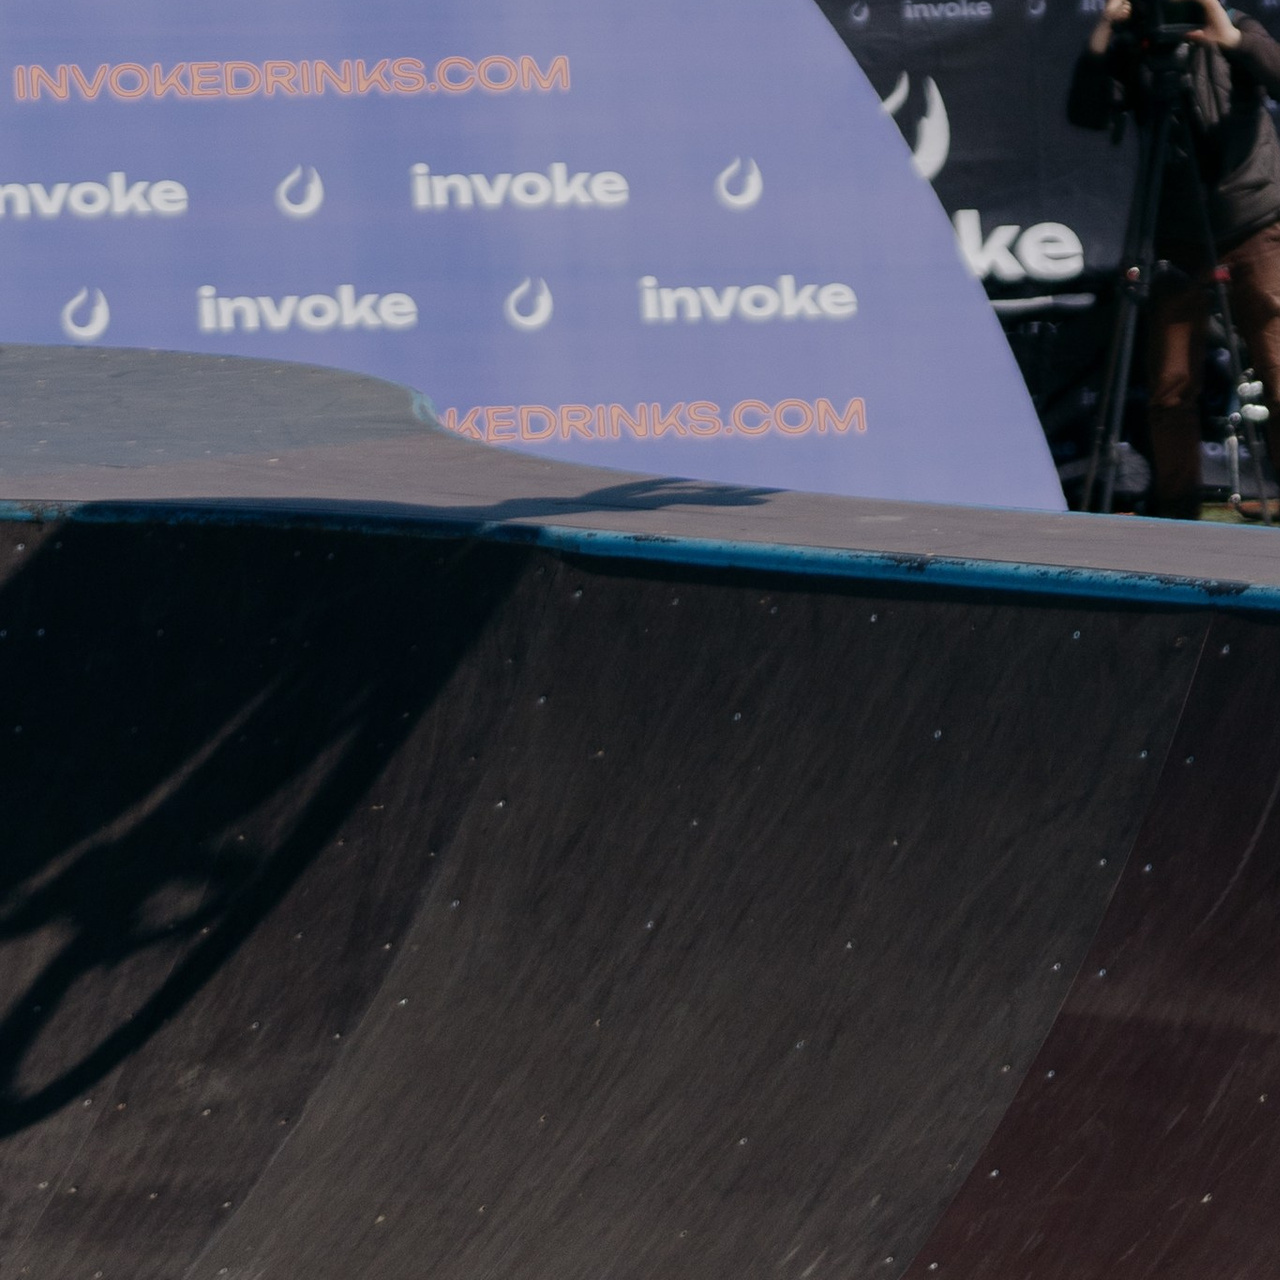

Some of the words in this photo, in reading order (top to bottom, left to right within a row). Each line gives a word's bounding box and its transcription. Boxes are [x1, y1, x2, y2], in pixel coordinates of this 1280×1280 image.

[13, 54, 571, 102] INVOKEDRINKS.COM
[0, 171, 188, 217] nvoke
[411, 163, 629, 209] invoke
[198, 285, 417, 331] invoke
[640, 275, 857, 321] invoke
[445, 396, 867, 442] KEDRINKS.COM
